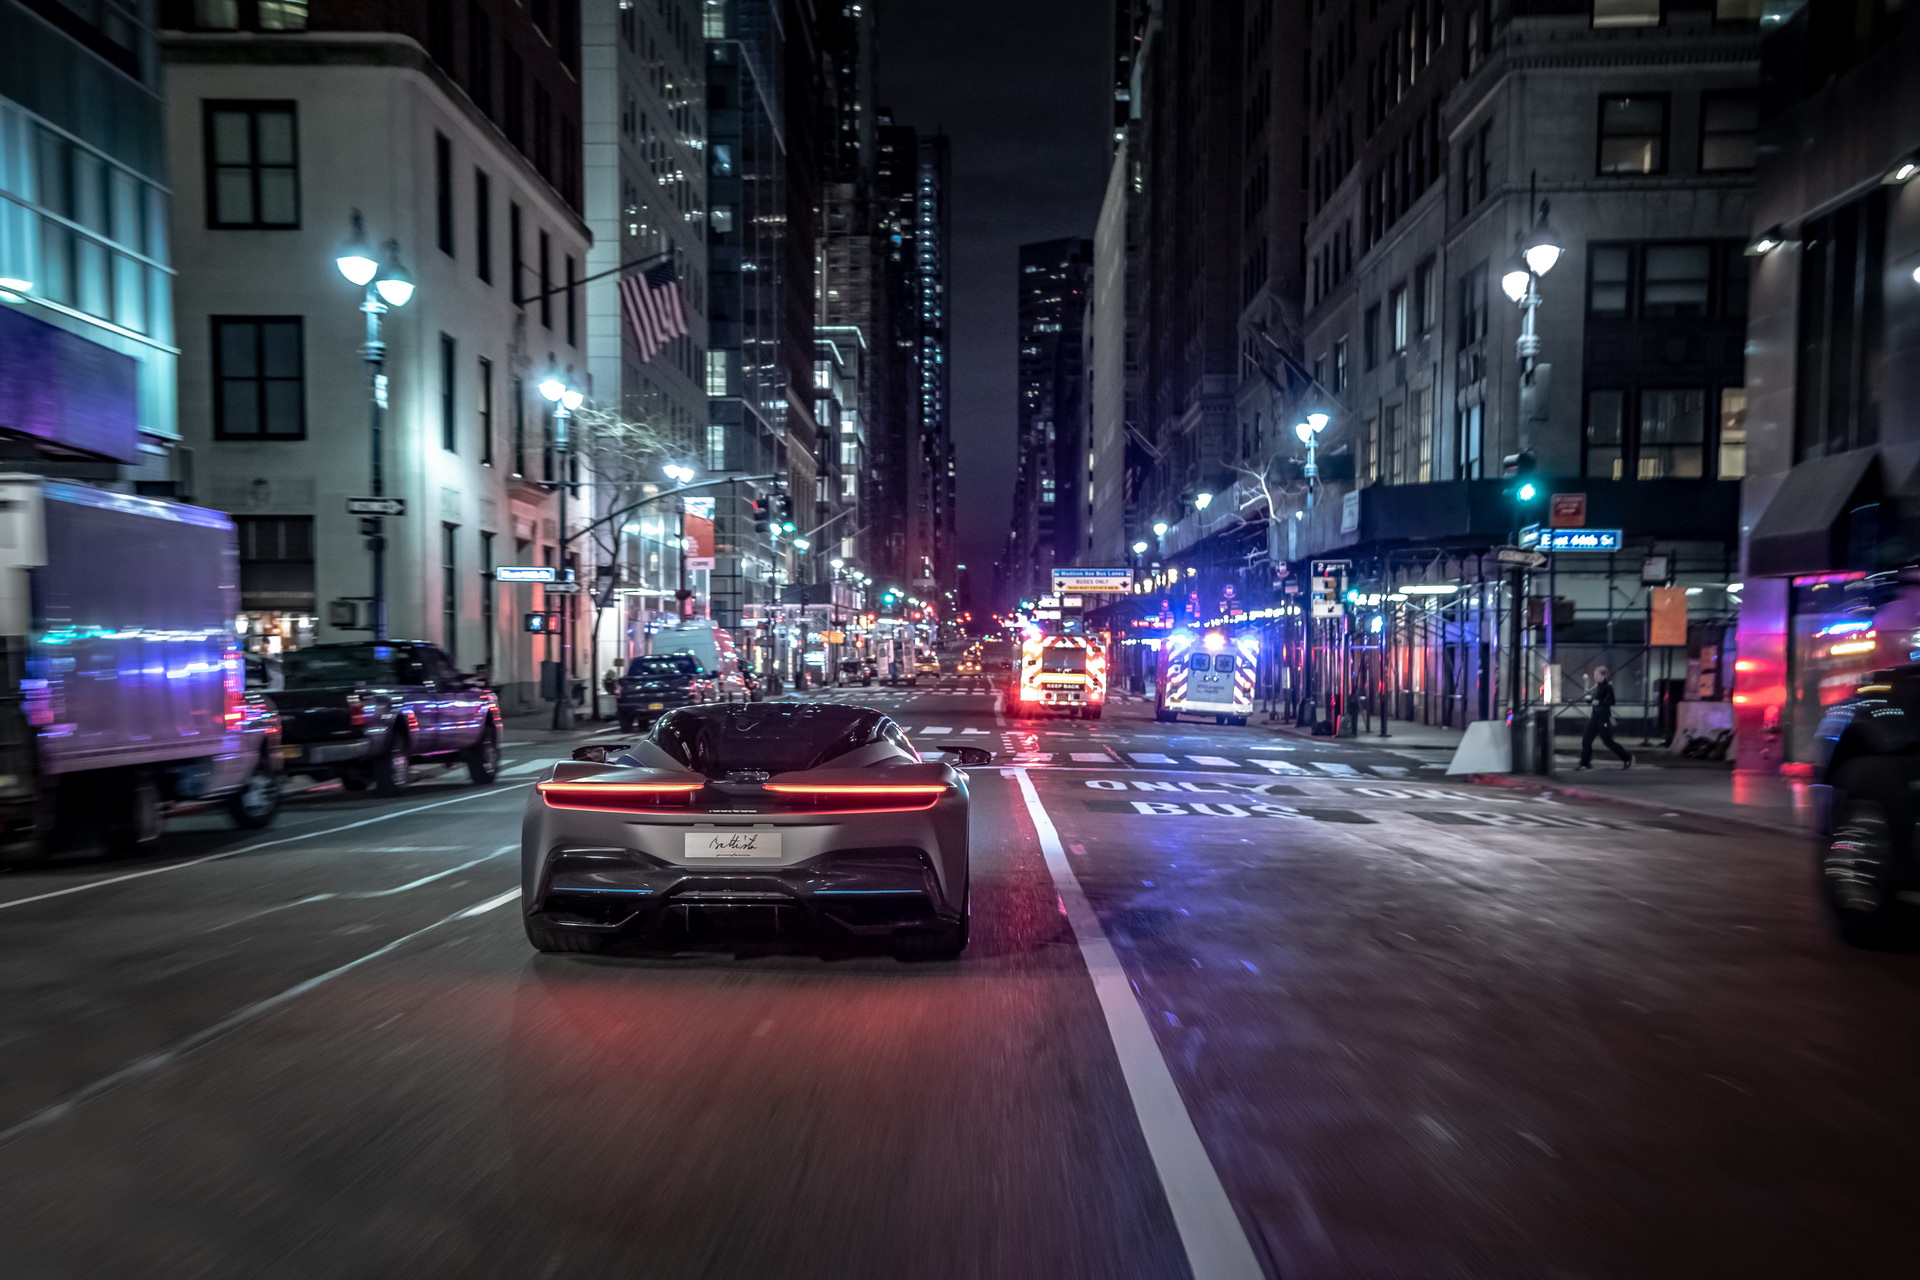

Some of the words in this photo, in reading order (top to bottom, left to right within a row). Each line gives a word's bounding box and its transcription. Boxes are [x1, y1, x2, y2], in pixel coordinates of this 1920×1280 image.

[1600, 534, 1614, 546] St
[1317, 562, 1324, 572] 2
[1084, 779, 1275, 794] ONLY
[1130, 801, 1315, 819] BUS
